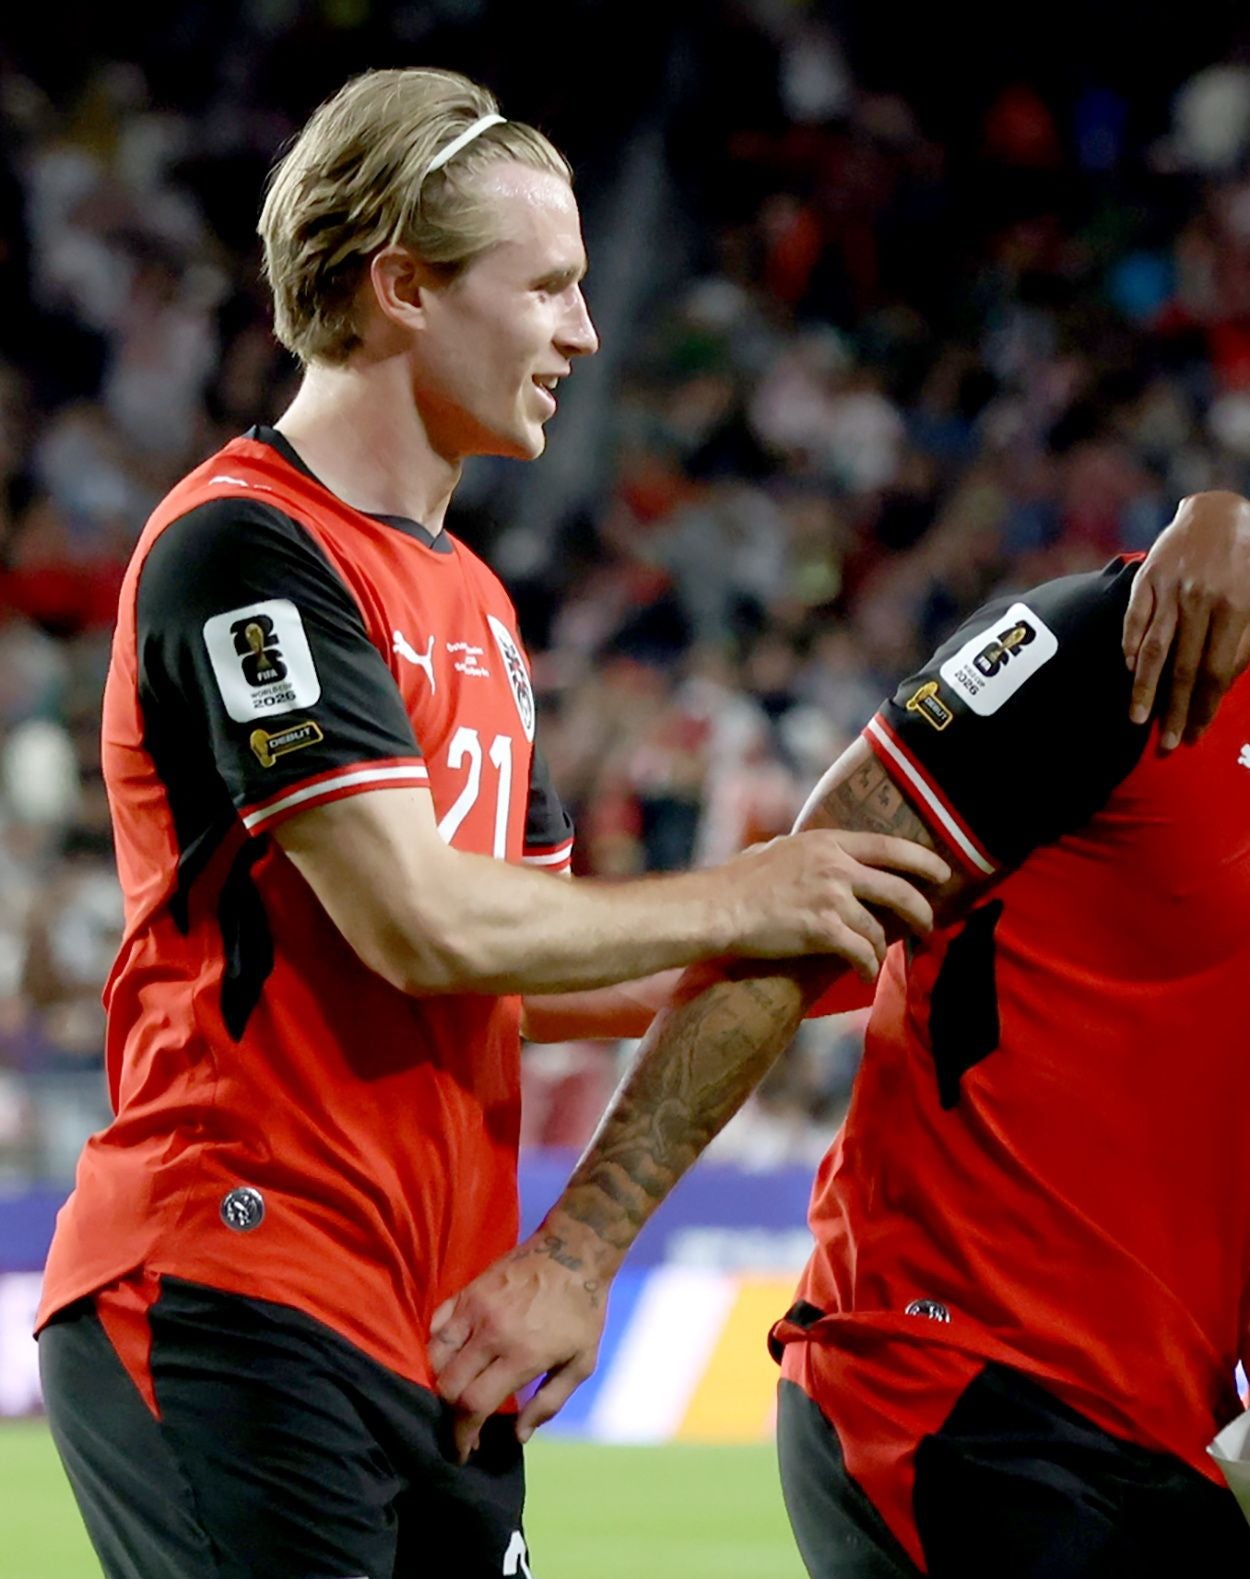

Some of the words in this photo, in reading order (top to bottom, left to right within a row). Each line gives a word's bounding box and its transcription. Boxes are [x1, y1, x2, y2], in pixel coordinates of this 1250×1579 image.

[954, 670, 980, 696] 2026
[253, 691, 296, 708] 2026
[269, 727, 310, 749] DEBUT
[437, 726, 512, 860] 21
